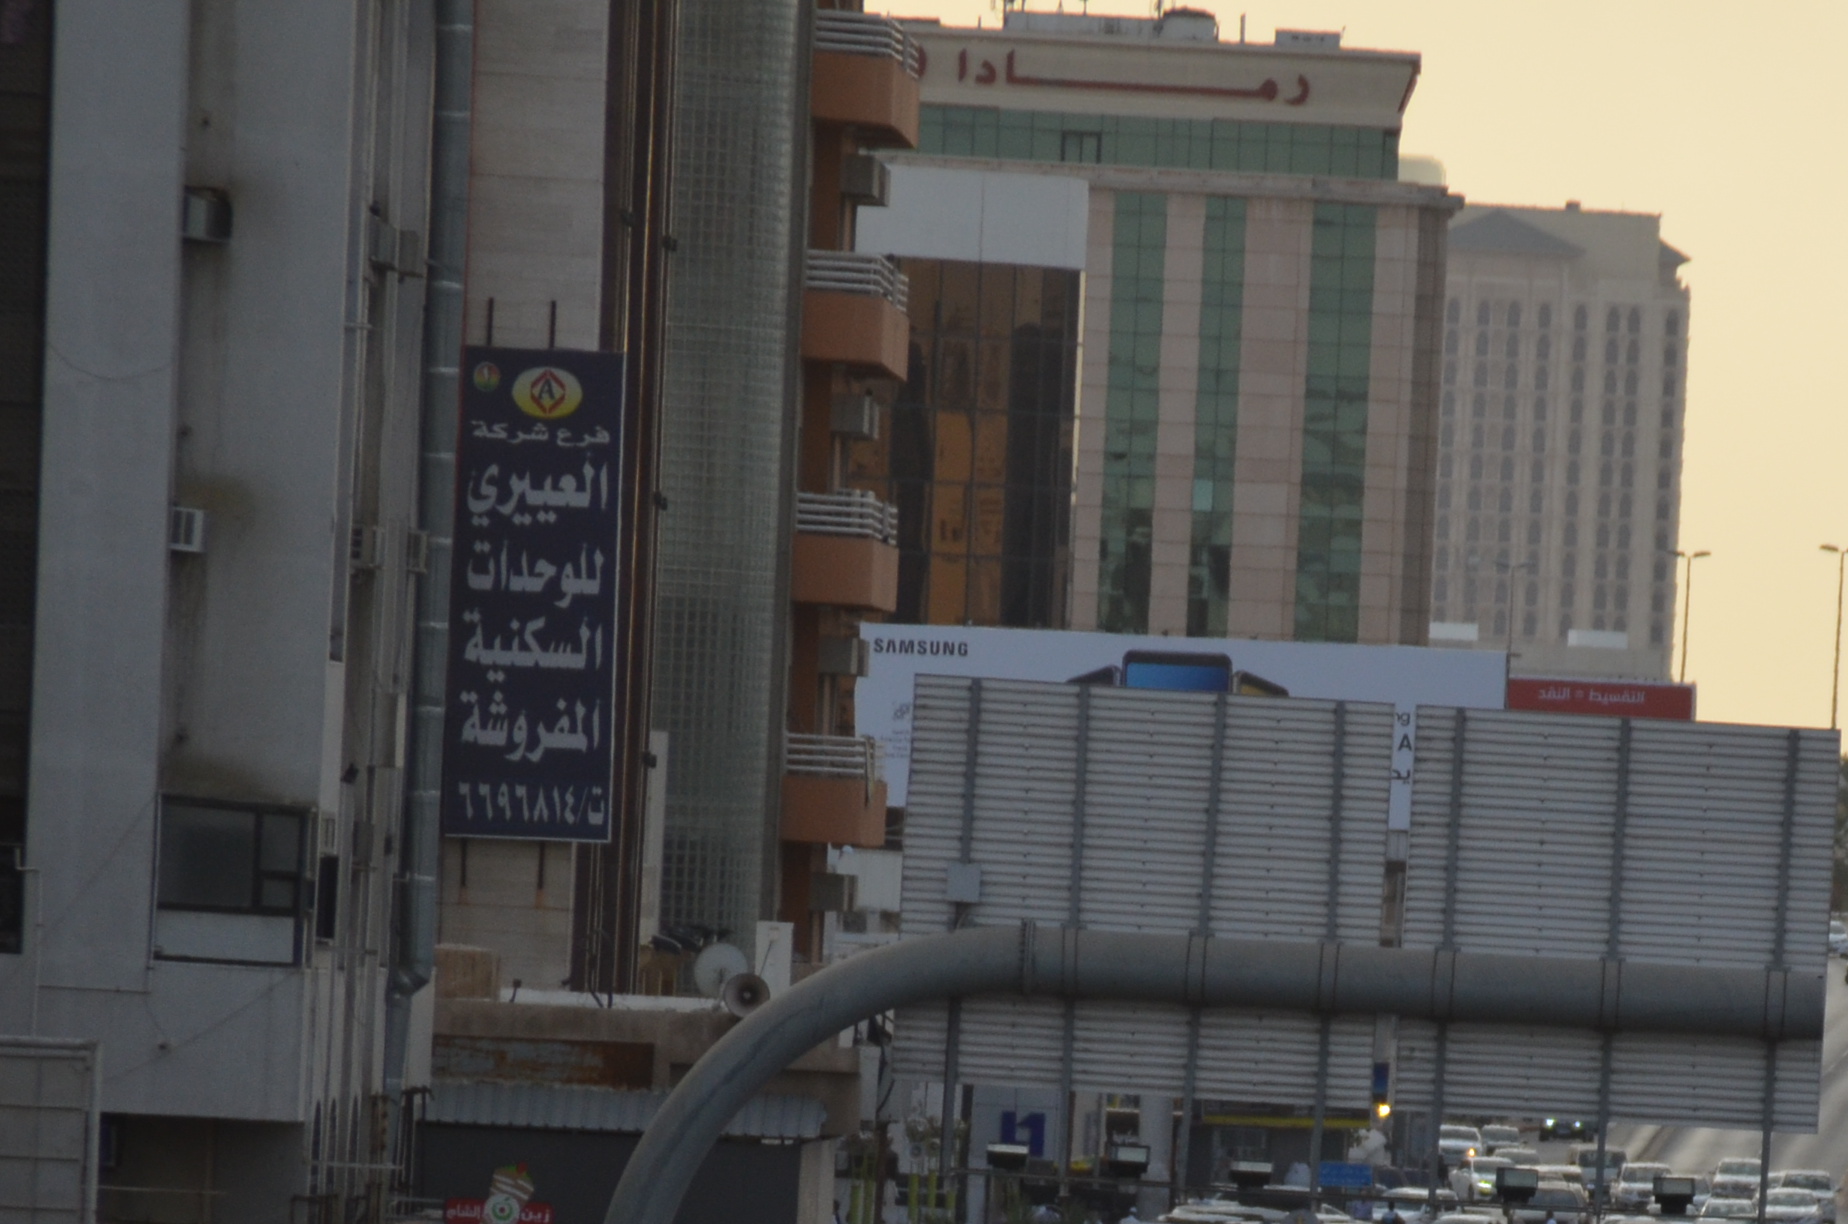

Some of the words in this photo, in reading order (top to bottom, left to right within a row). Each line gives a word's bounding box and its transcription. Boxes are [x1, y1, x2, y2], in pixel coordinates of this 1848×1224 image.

[957, 48, 1310, 105] رمادا
[538, 378, 557, 401] A
[471, 419, 549, 444] شركة
[557, 421, 610, 447] فرع
[467, 539, 604, 608] للوحدات
[463, 608, 603, 682] السكنية
[873, 636, 969, 657] SAMSUNG
[459, 689, 602, 763] المفروشة
[446, 1203, 481, 1219] الشام
[520, 1208, 551, 1224] زين
